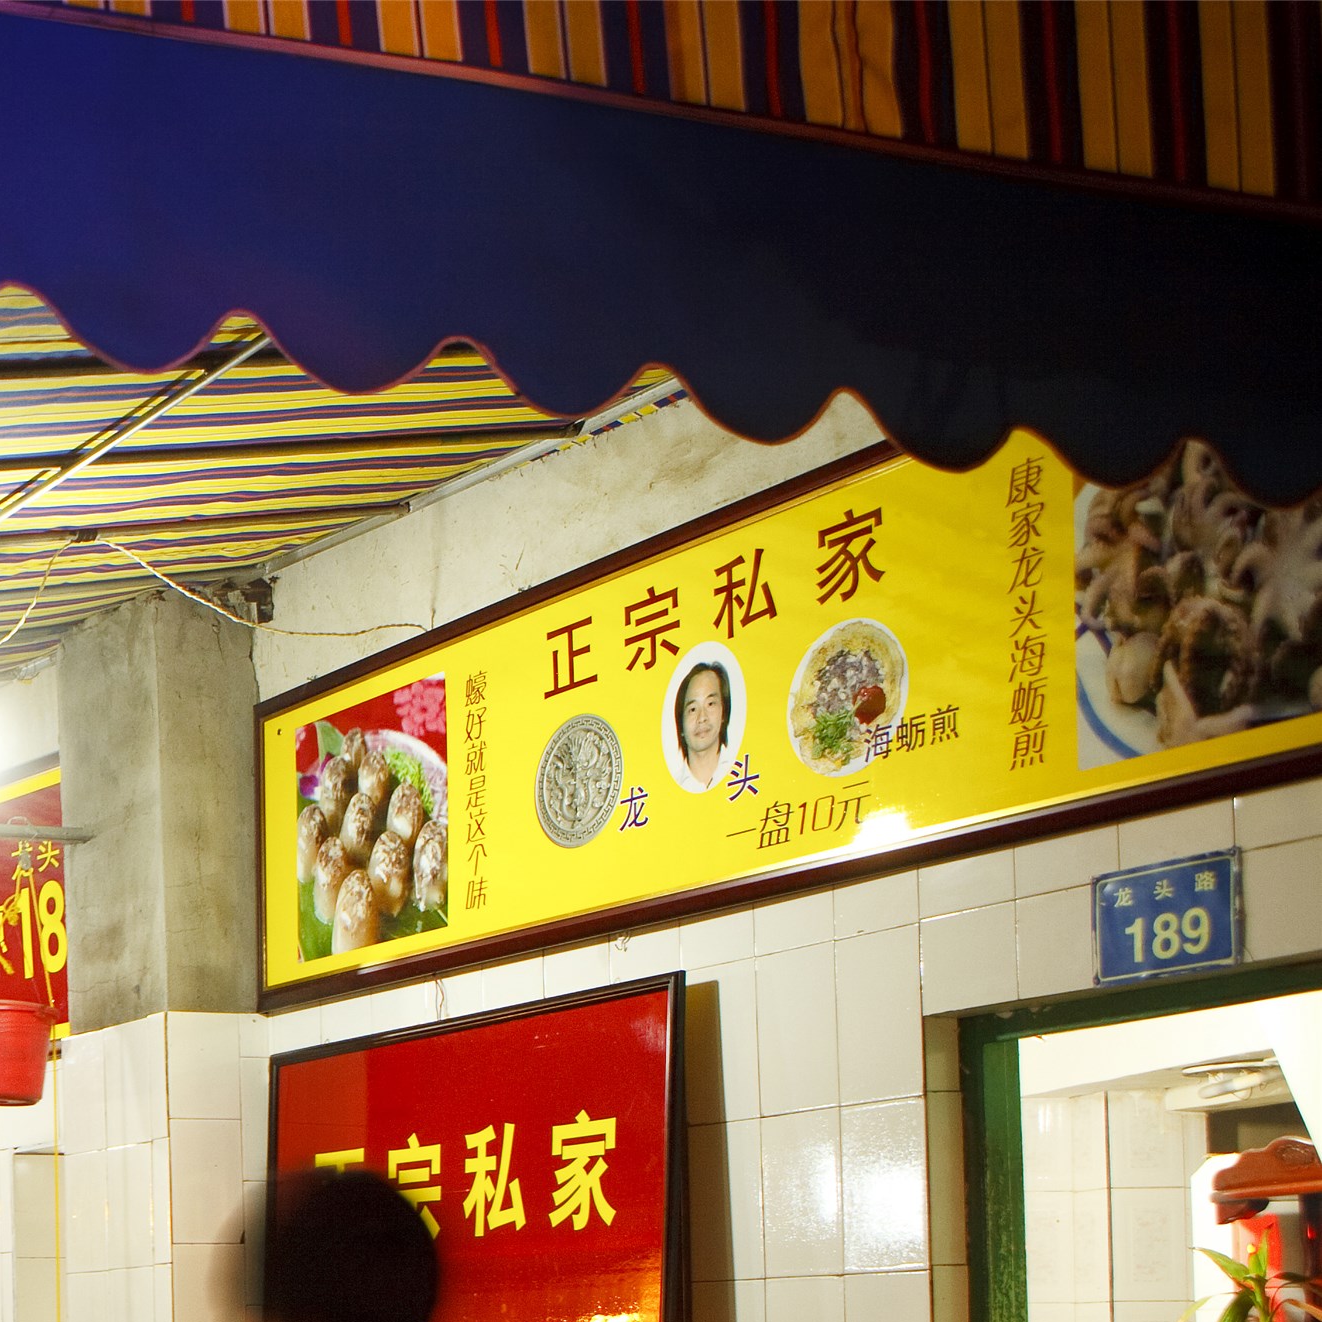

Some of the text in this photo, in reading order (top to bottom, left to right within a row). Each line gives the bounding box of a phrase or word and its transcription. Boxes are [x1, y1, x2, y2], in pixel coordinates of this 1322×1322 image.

[544, 507, 885, 700] 正宗私家
[1006, 456, 1049, 772] 康家龙头海蛎煎
[618, 704, 962, 833] 龙 头 海蛎煎
[726, 781, 871, 850] 一盘10元
[1114, 871, 1217, 908] 龙头路
[1124, 907, 1211, 963] 189
[315, 1109, 617, 1239] 宗私家
